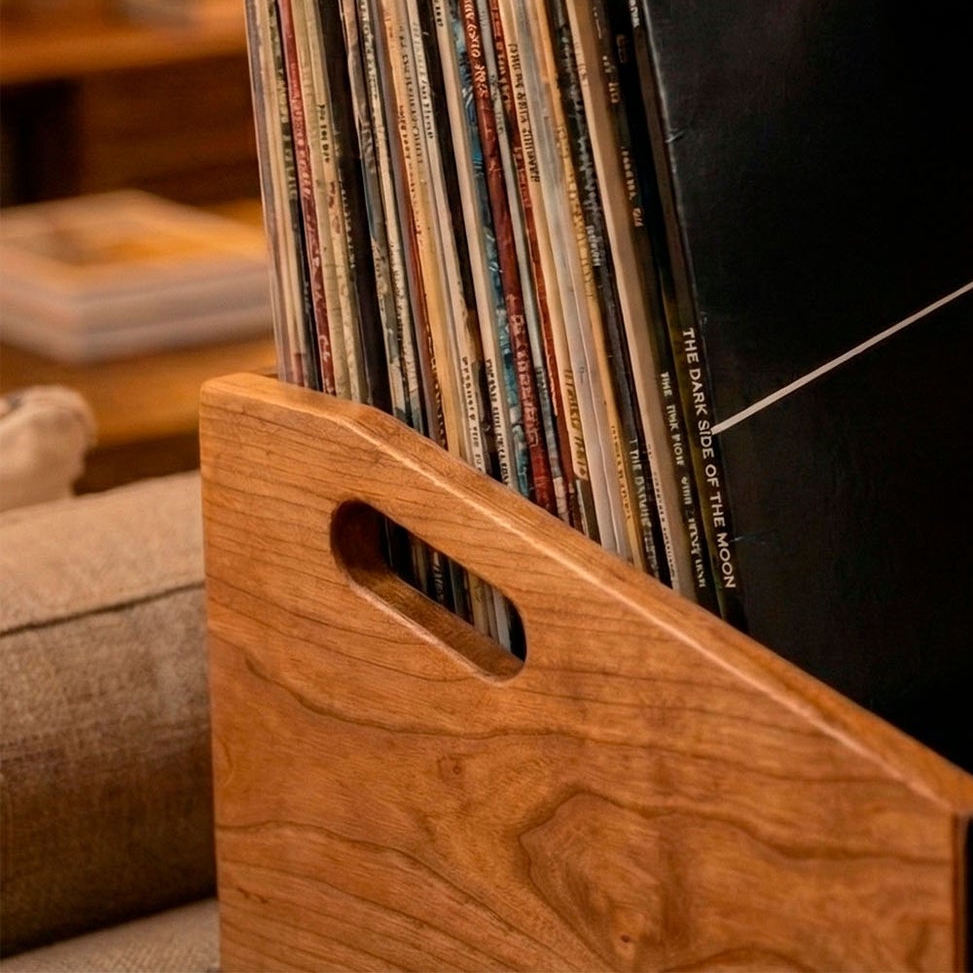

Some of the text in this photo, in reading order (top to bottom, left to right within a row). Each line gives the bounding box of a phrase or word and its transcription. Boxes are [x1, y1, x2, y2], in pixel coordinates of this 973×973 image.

[682, 327, 736, 588] THE DARK SIDE OF THE MOON
